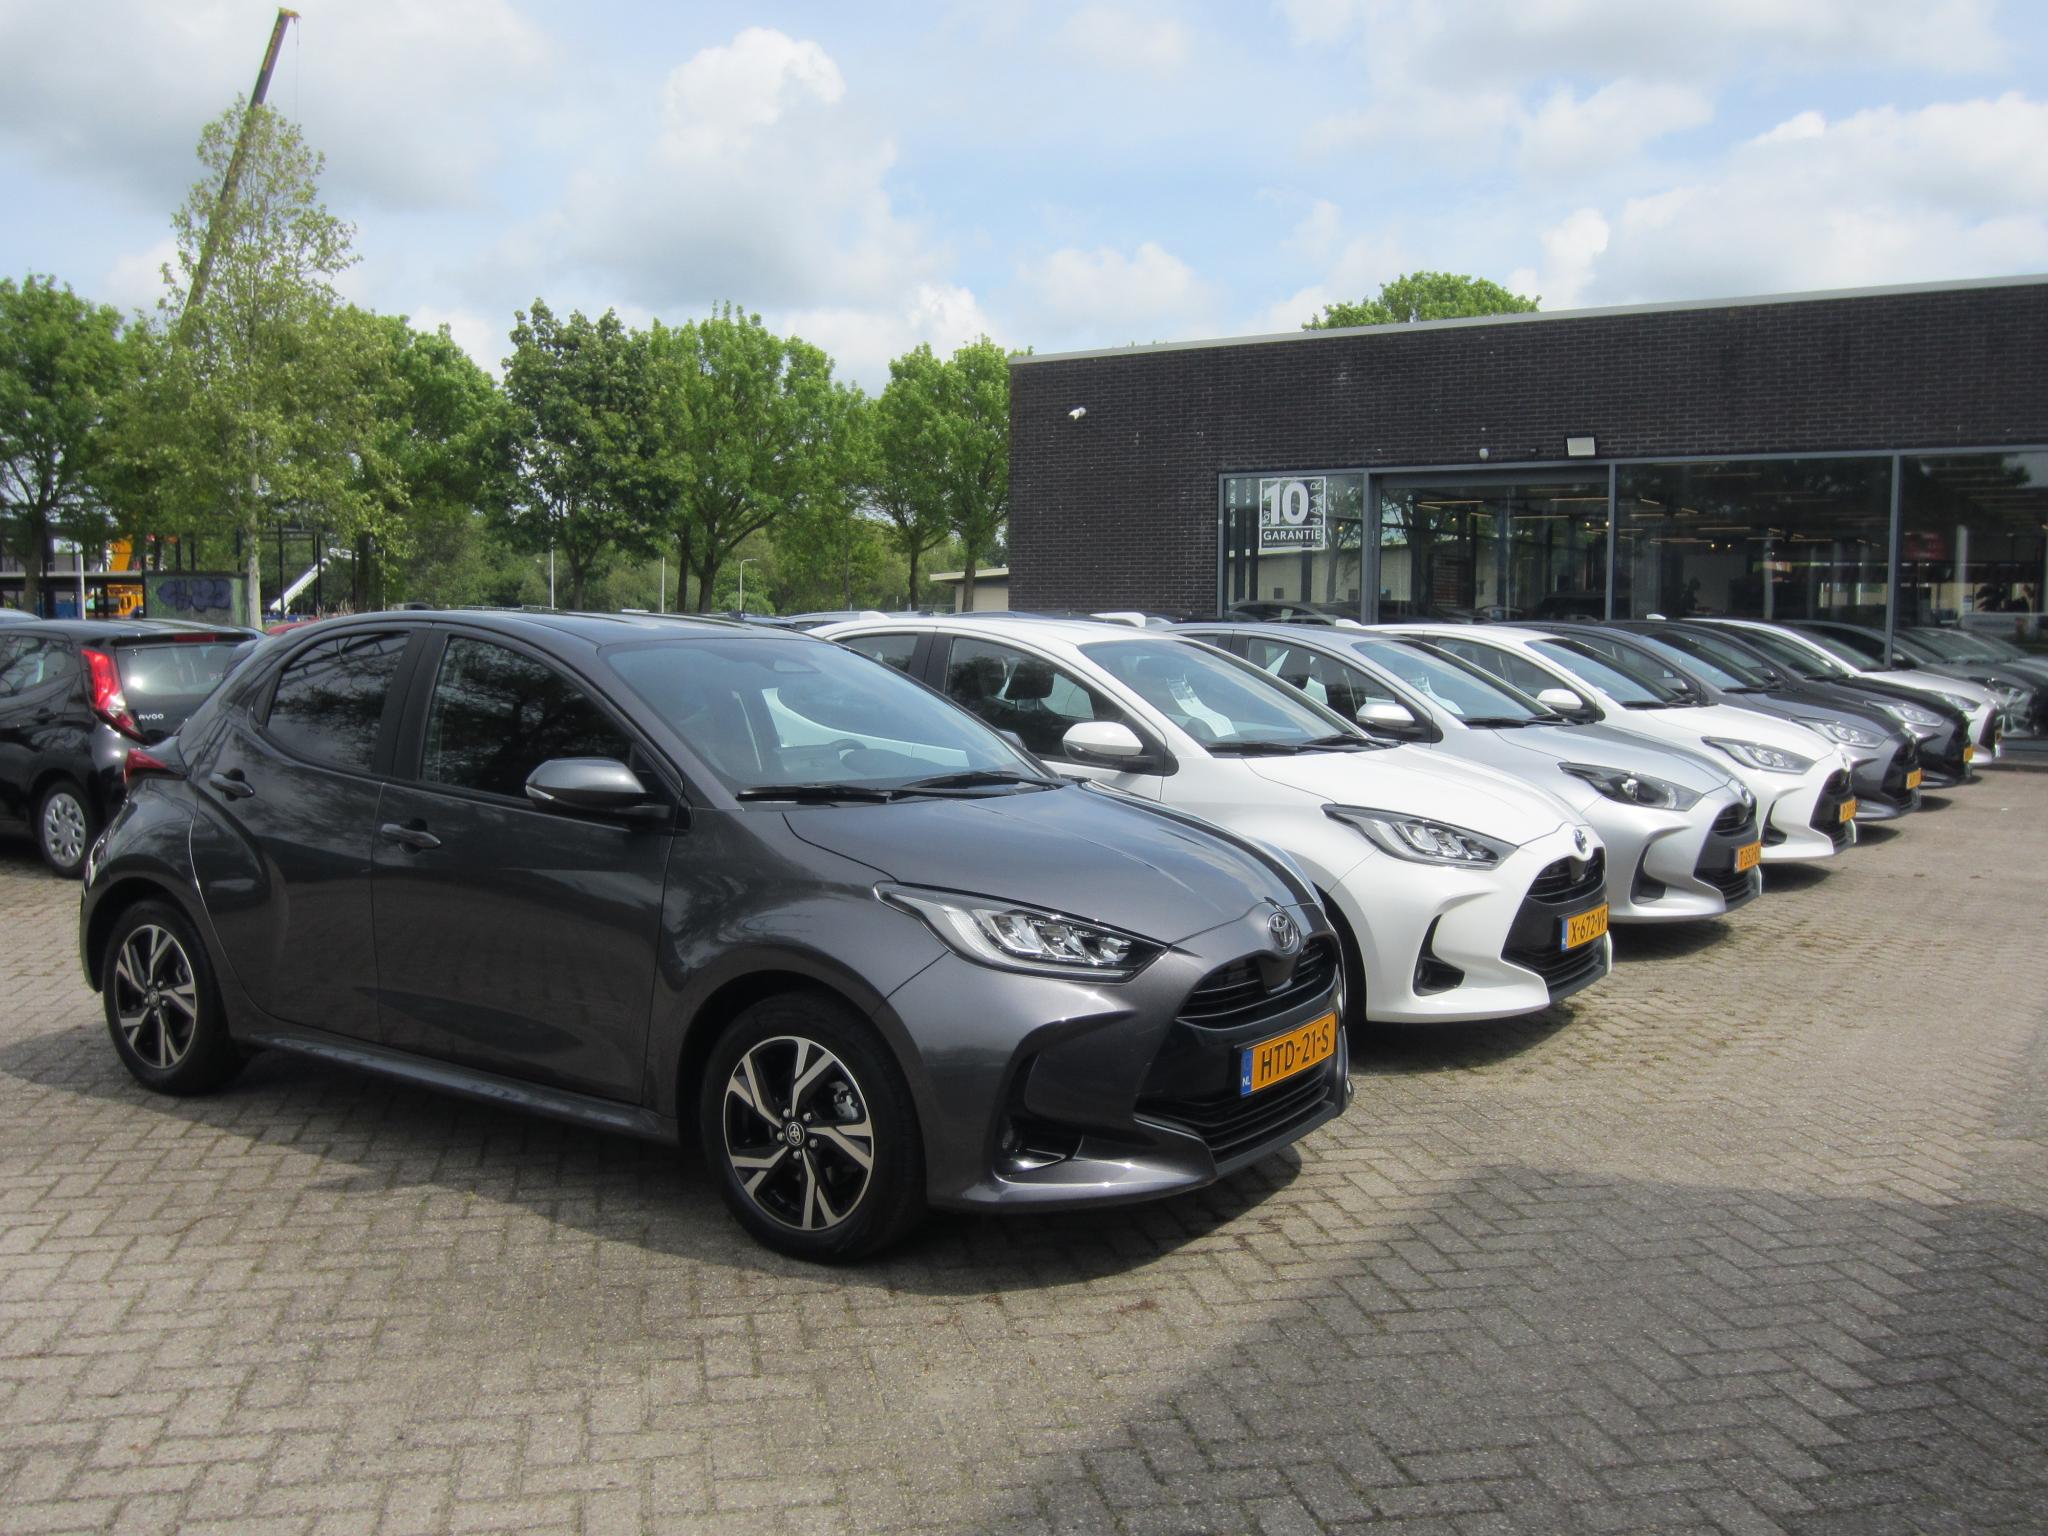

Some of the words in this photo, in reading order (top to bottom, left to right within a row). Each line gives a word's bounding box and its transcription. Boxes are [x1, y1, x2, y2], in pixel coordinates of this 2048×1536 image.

[1264, 482, 1309, 524] 10
[1310, 481, 1321, 525] JAAR
[1263, 530, 1321, 540] GARANTIE
[1260, 1023, 1329, 1081] HTD-21-S
[1242, 1076, 1250, 1087] NL
